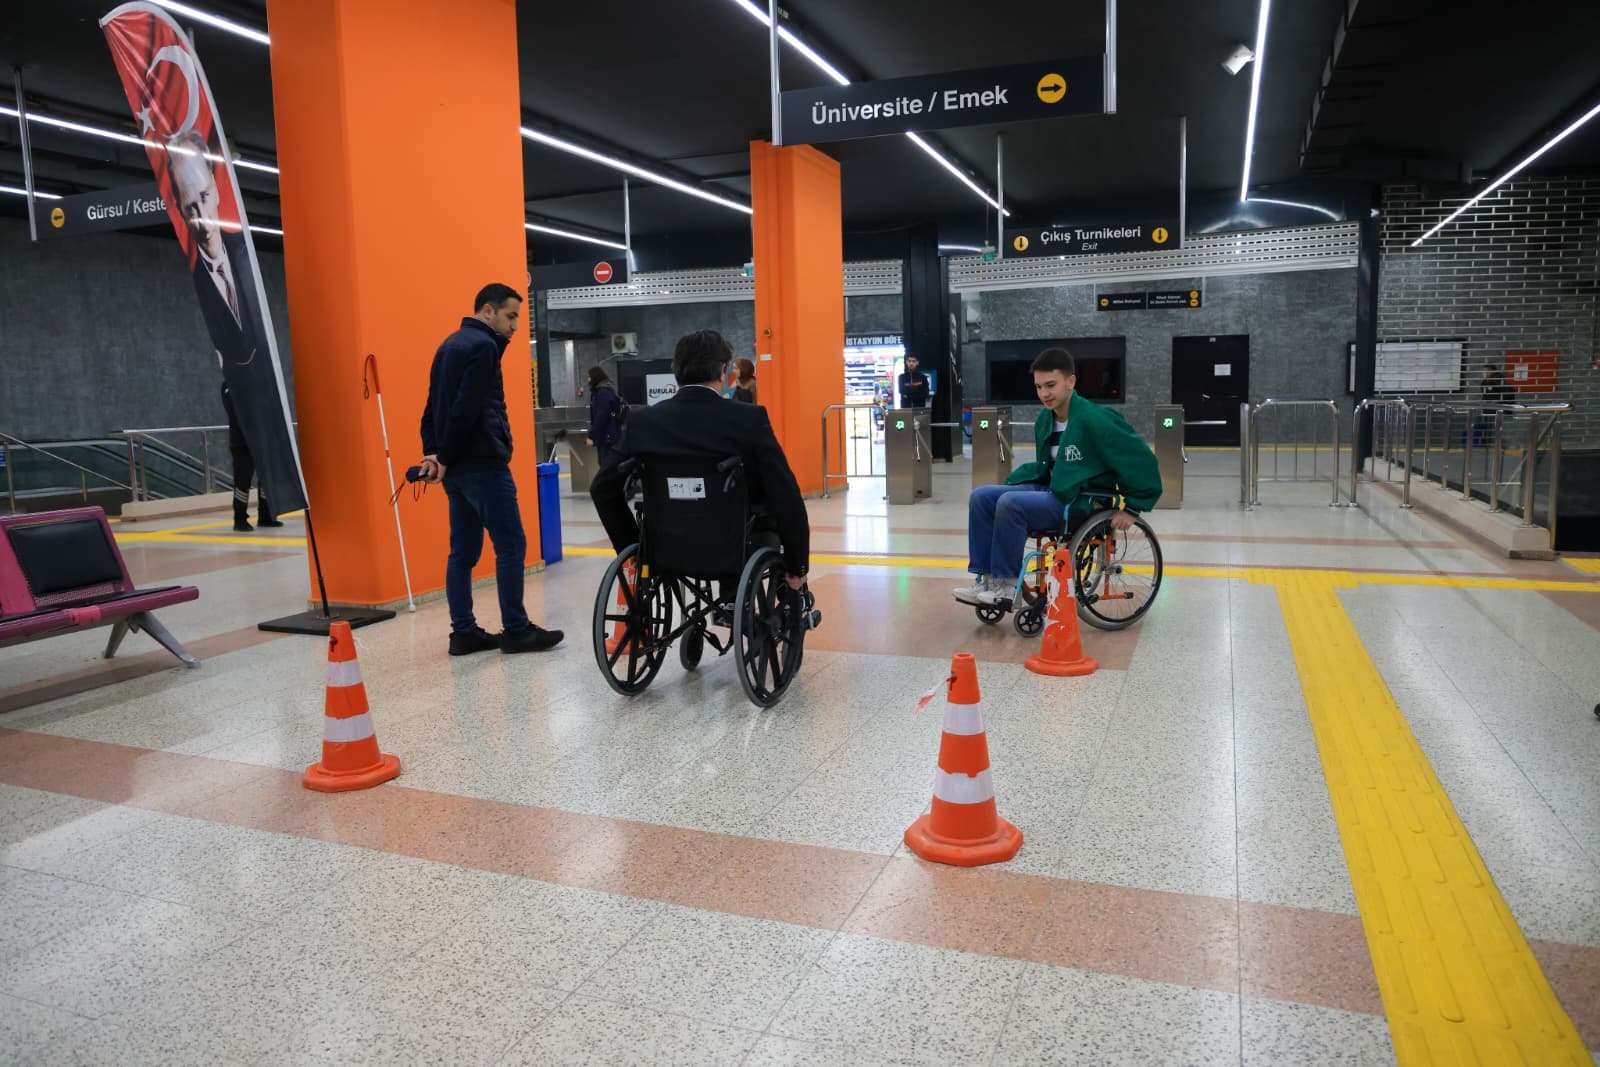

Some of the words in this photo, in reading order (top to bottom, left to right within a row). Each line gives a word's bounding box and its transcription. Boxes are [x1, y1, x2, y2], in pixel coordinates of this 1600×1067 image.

[811, 97, 923, 125] Üniversite
[927, 91, 938, 113] /
[943, 85, 1008, 111] Emek
[87, 204, 123, 220] Gürsu
[133, 198, 166, 214] Keste
[1040, 231, 1071, 244] Çıkış
[1075, 226, 1141, 240] Turnikeleri
[1081, 242, 1098, 251] Exit
